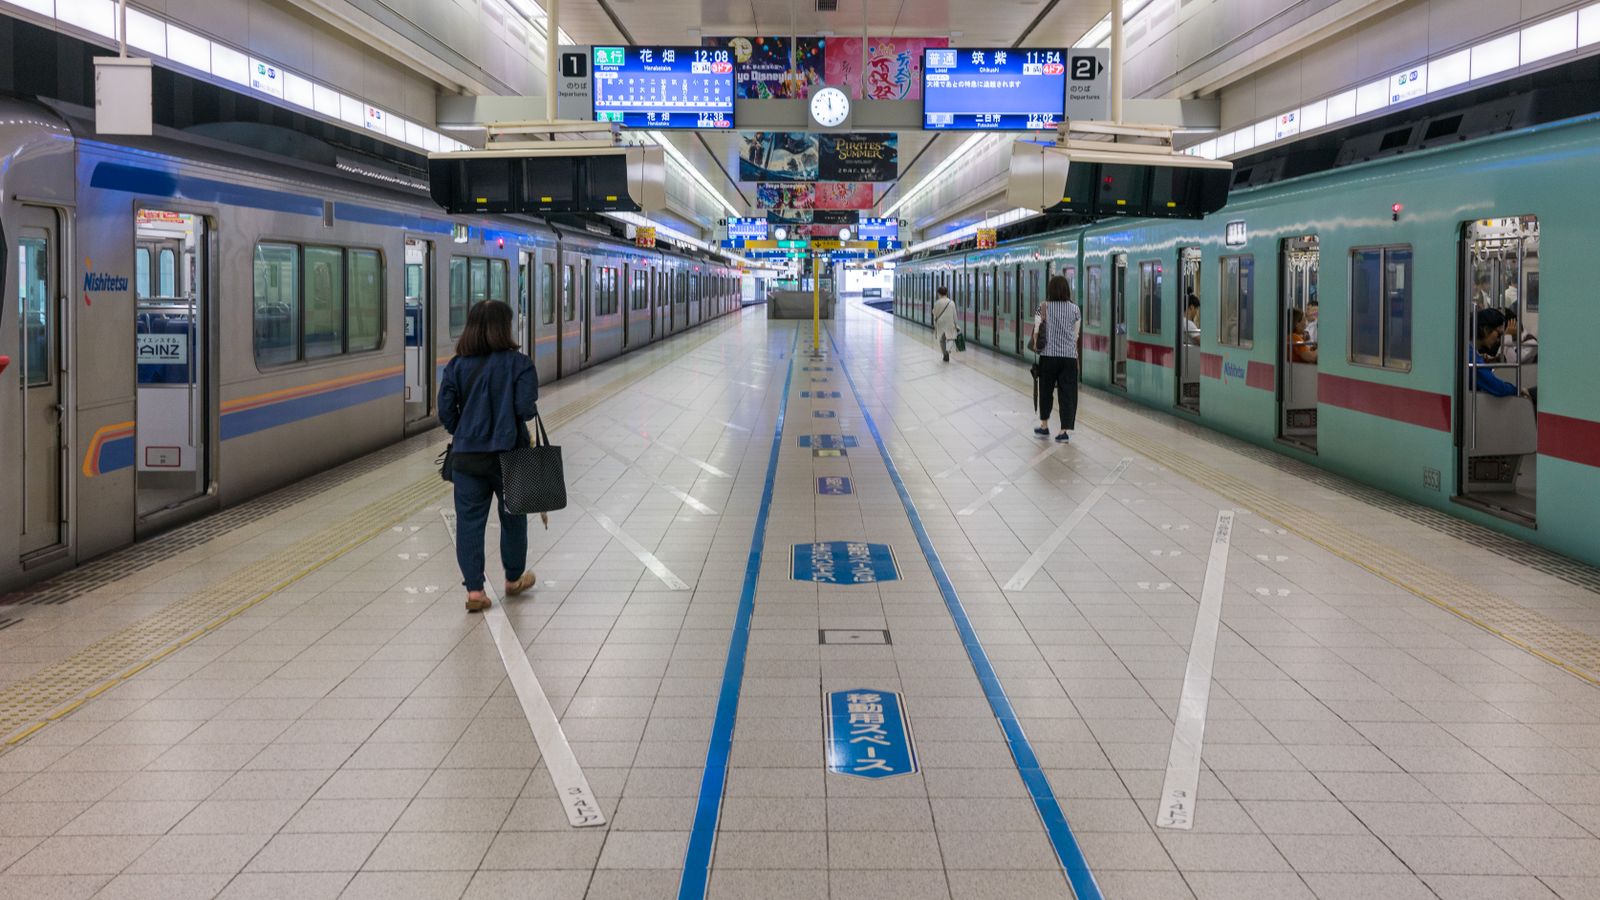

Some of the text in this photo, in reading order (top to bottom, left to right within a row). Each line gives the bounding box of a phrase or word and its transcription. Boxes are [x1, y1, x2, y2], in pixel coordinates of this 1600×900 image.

[597, 50, 622, 63] 急行
[640, 49, 675, 63] 花畑
[694, 50, 728, 62] 12:08
[929, 52, 955, 65] 普通
[972, 51, 1007, 65] 筑紫
[1026, 51, 1060, 64] 11:54
[570, 57, 577, 74] 1
[1076, 60, 1091, 77] 2
[699, 112, 723, 121] 12:38
[976, 114, 1001, 122] 二日市
[1028, 113, 1053, 122] 12:02
[834, 138, 880, 150] PIRATES
[838, 149, 883, 160] SUMMER
[886, 241, 892, 249] 2
[84, 272, 128, 291] Nishitetsu
[136, 344, 180, 356] AINZ
[846, 692, 894, 772] 移動用スペース
